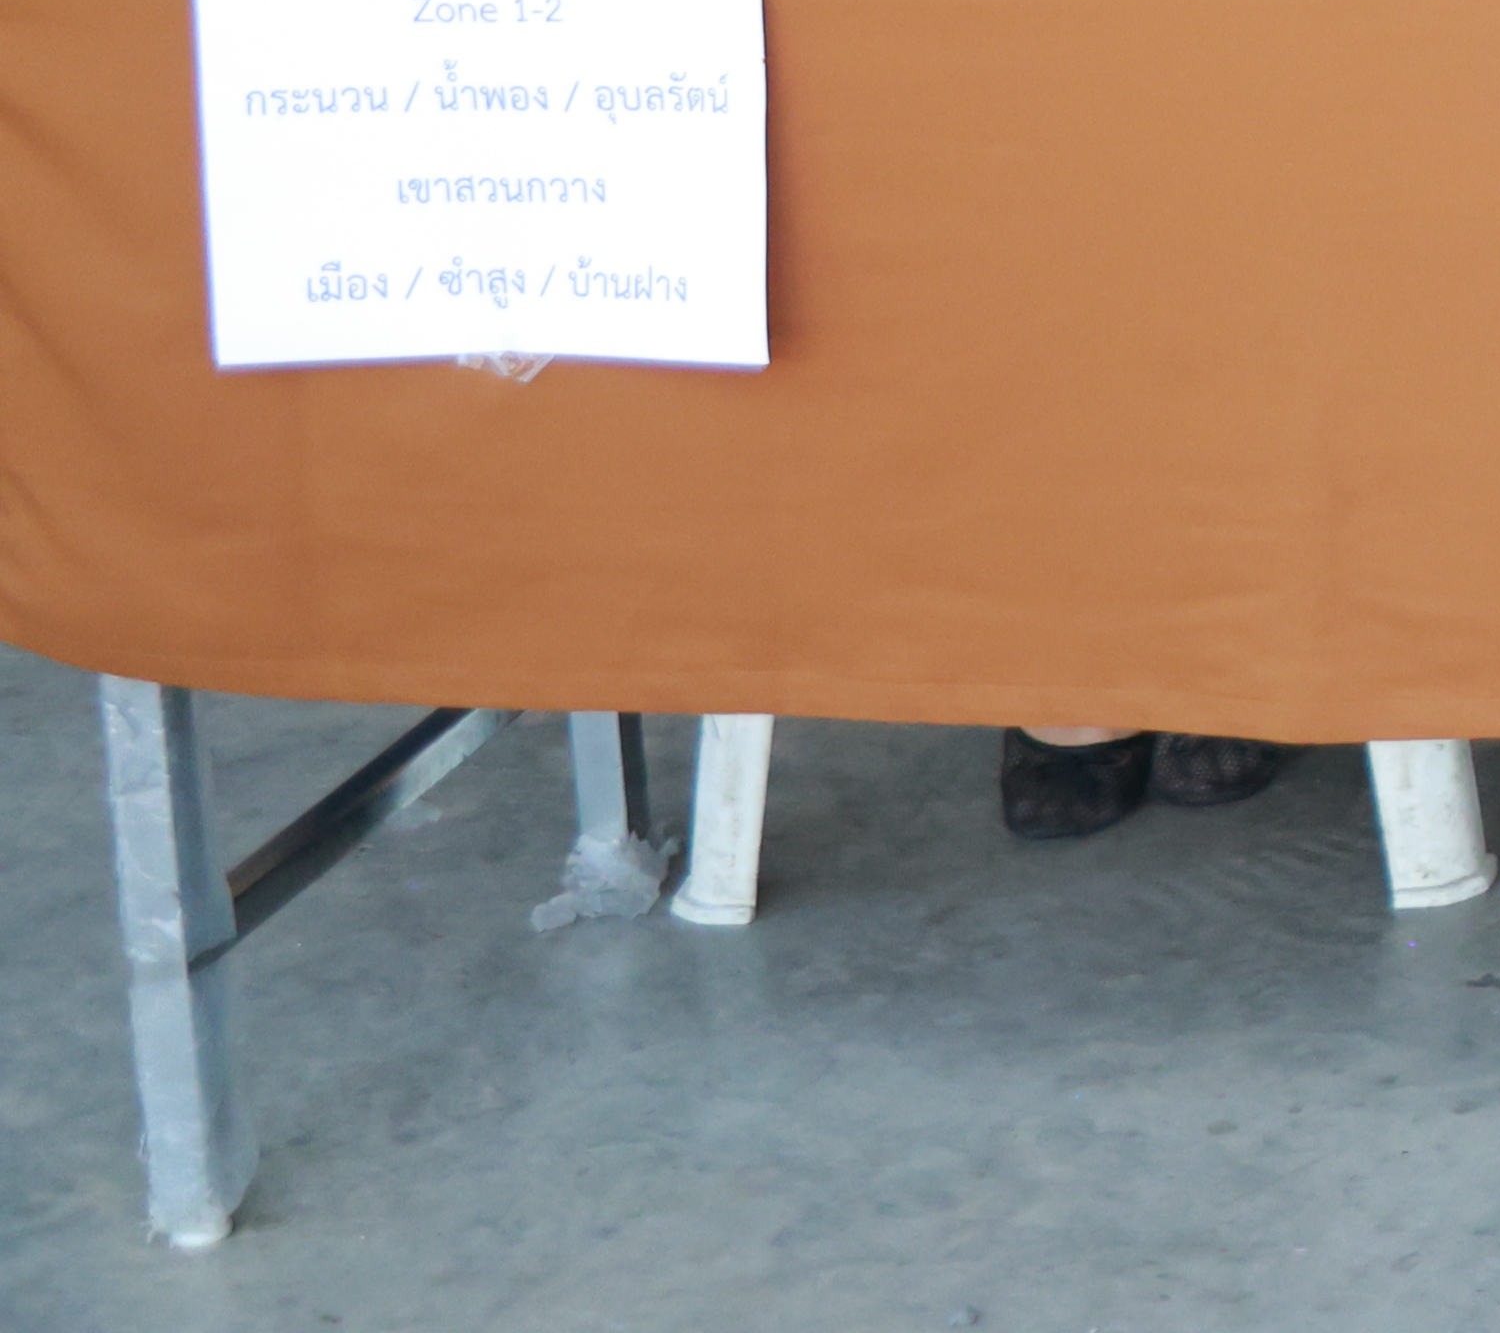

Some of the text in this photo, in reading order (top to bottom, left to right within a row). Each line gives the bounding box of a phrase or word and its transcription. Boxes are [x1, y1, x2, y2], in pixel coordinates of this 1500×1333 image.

[244, 85, 390, 117] กระนวน
[433, 58, 550, 113] น้ำพอง
[396, 175, 607, 205] เขาสวนกวาง
[305, 259, 390, 304] เมือง
[567, 255, 688, 303] บ้านฝาง
